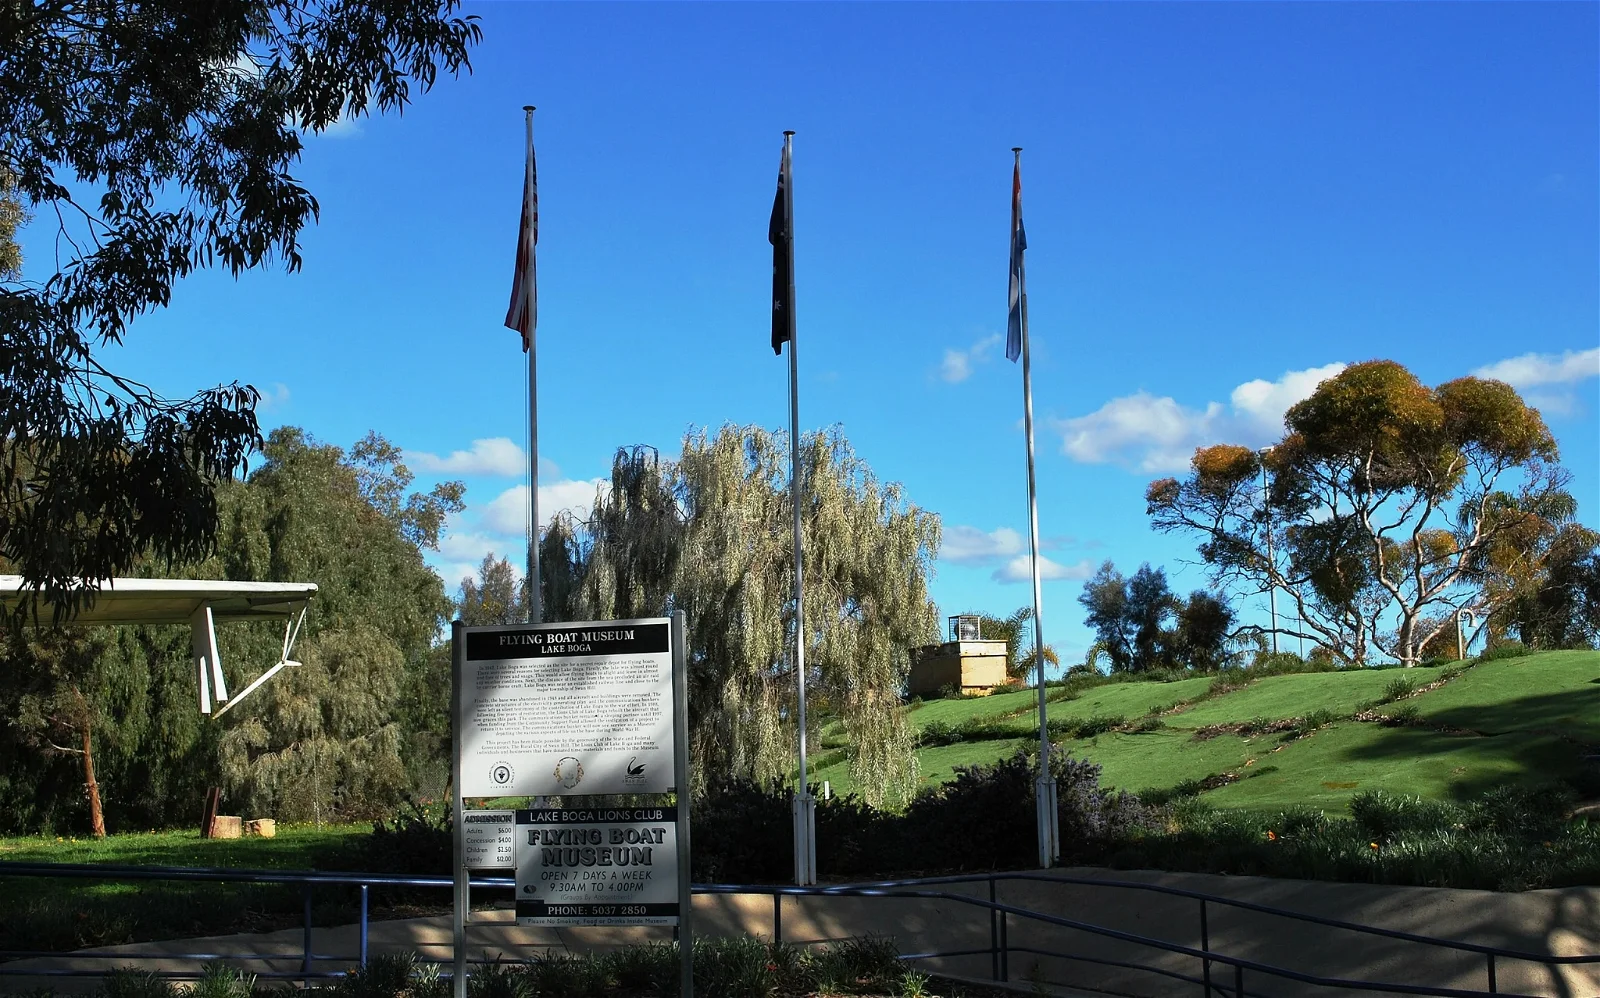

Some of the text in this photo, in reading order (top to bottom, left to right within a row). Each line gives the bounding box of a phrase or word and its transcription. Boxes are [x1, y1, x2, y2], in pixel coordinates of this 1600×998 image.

[499, 630, 634, 645] FLYING BOAT MUSEUM
[541, 644, 591, 653] LAKE BOGA
[464, 815, 512, 823] ADMISSION
[530, 810, 663, 821] LAKE BOGA LIONS CLUB
[528, 828, 666, 845] FLYING BOAT
[541, 847, 652, 866] MUSEUM
[541, 871, 652, 880] OPEN 7 DAYS A WEEK
[550, 883, 644, 892] 9.30AM TO 4.00PM
[548, 906, 647, 915] PHONE: 5037 2850
